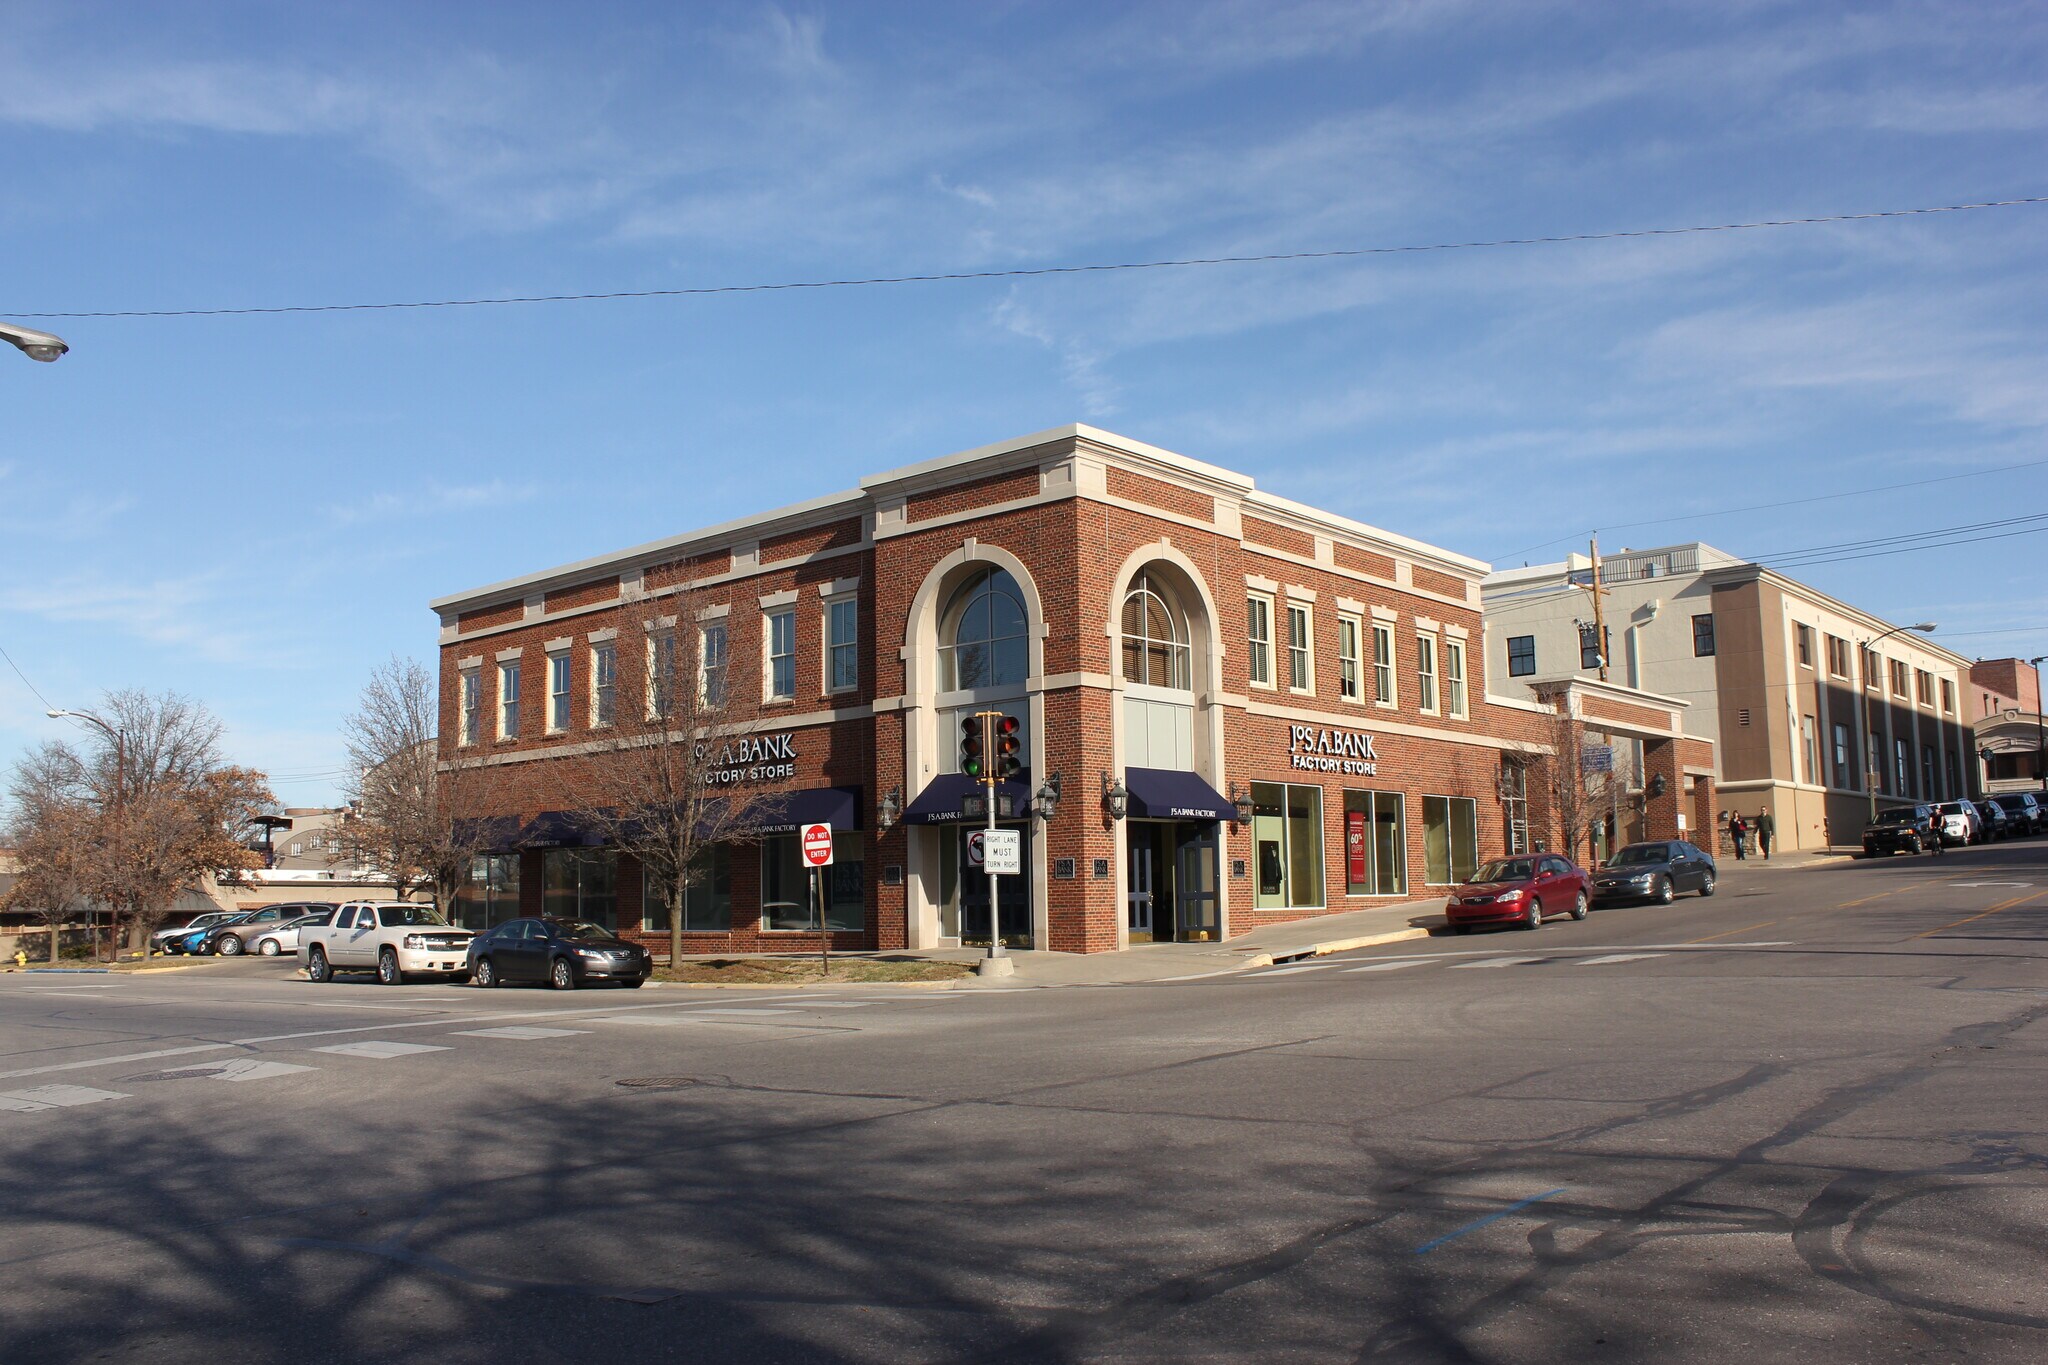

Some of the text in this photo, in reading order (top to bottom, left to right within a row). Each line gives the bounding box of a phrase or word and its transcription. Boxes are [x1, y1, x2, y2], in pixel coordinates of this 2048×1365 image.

[1292, 755, 1377, 775] FACTORY STORE
[694, 763, 794, 784] CTORY STORE
[1195, 809, 1217, 818] FACTORY
[774, 824, 797, 832] FACTORY
[817, 831, 827, 839] NOT
[1003, 836, 1017, 844] LANE
[810, 849, 827, 859] ENTER
[993, 848, 1012, 857] MUST
[987, 860, 1001, 868] TURN
